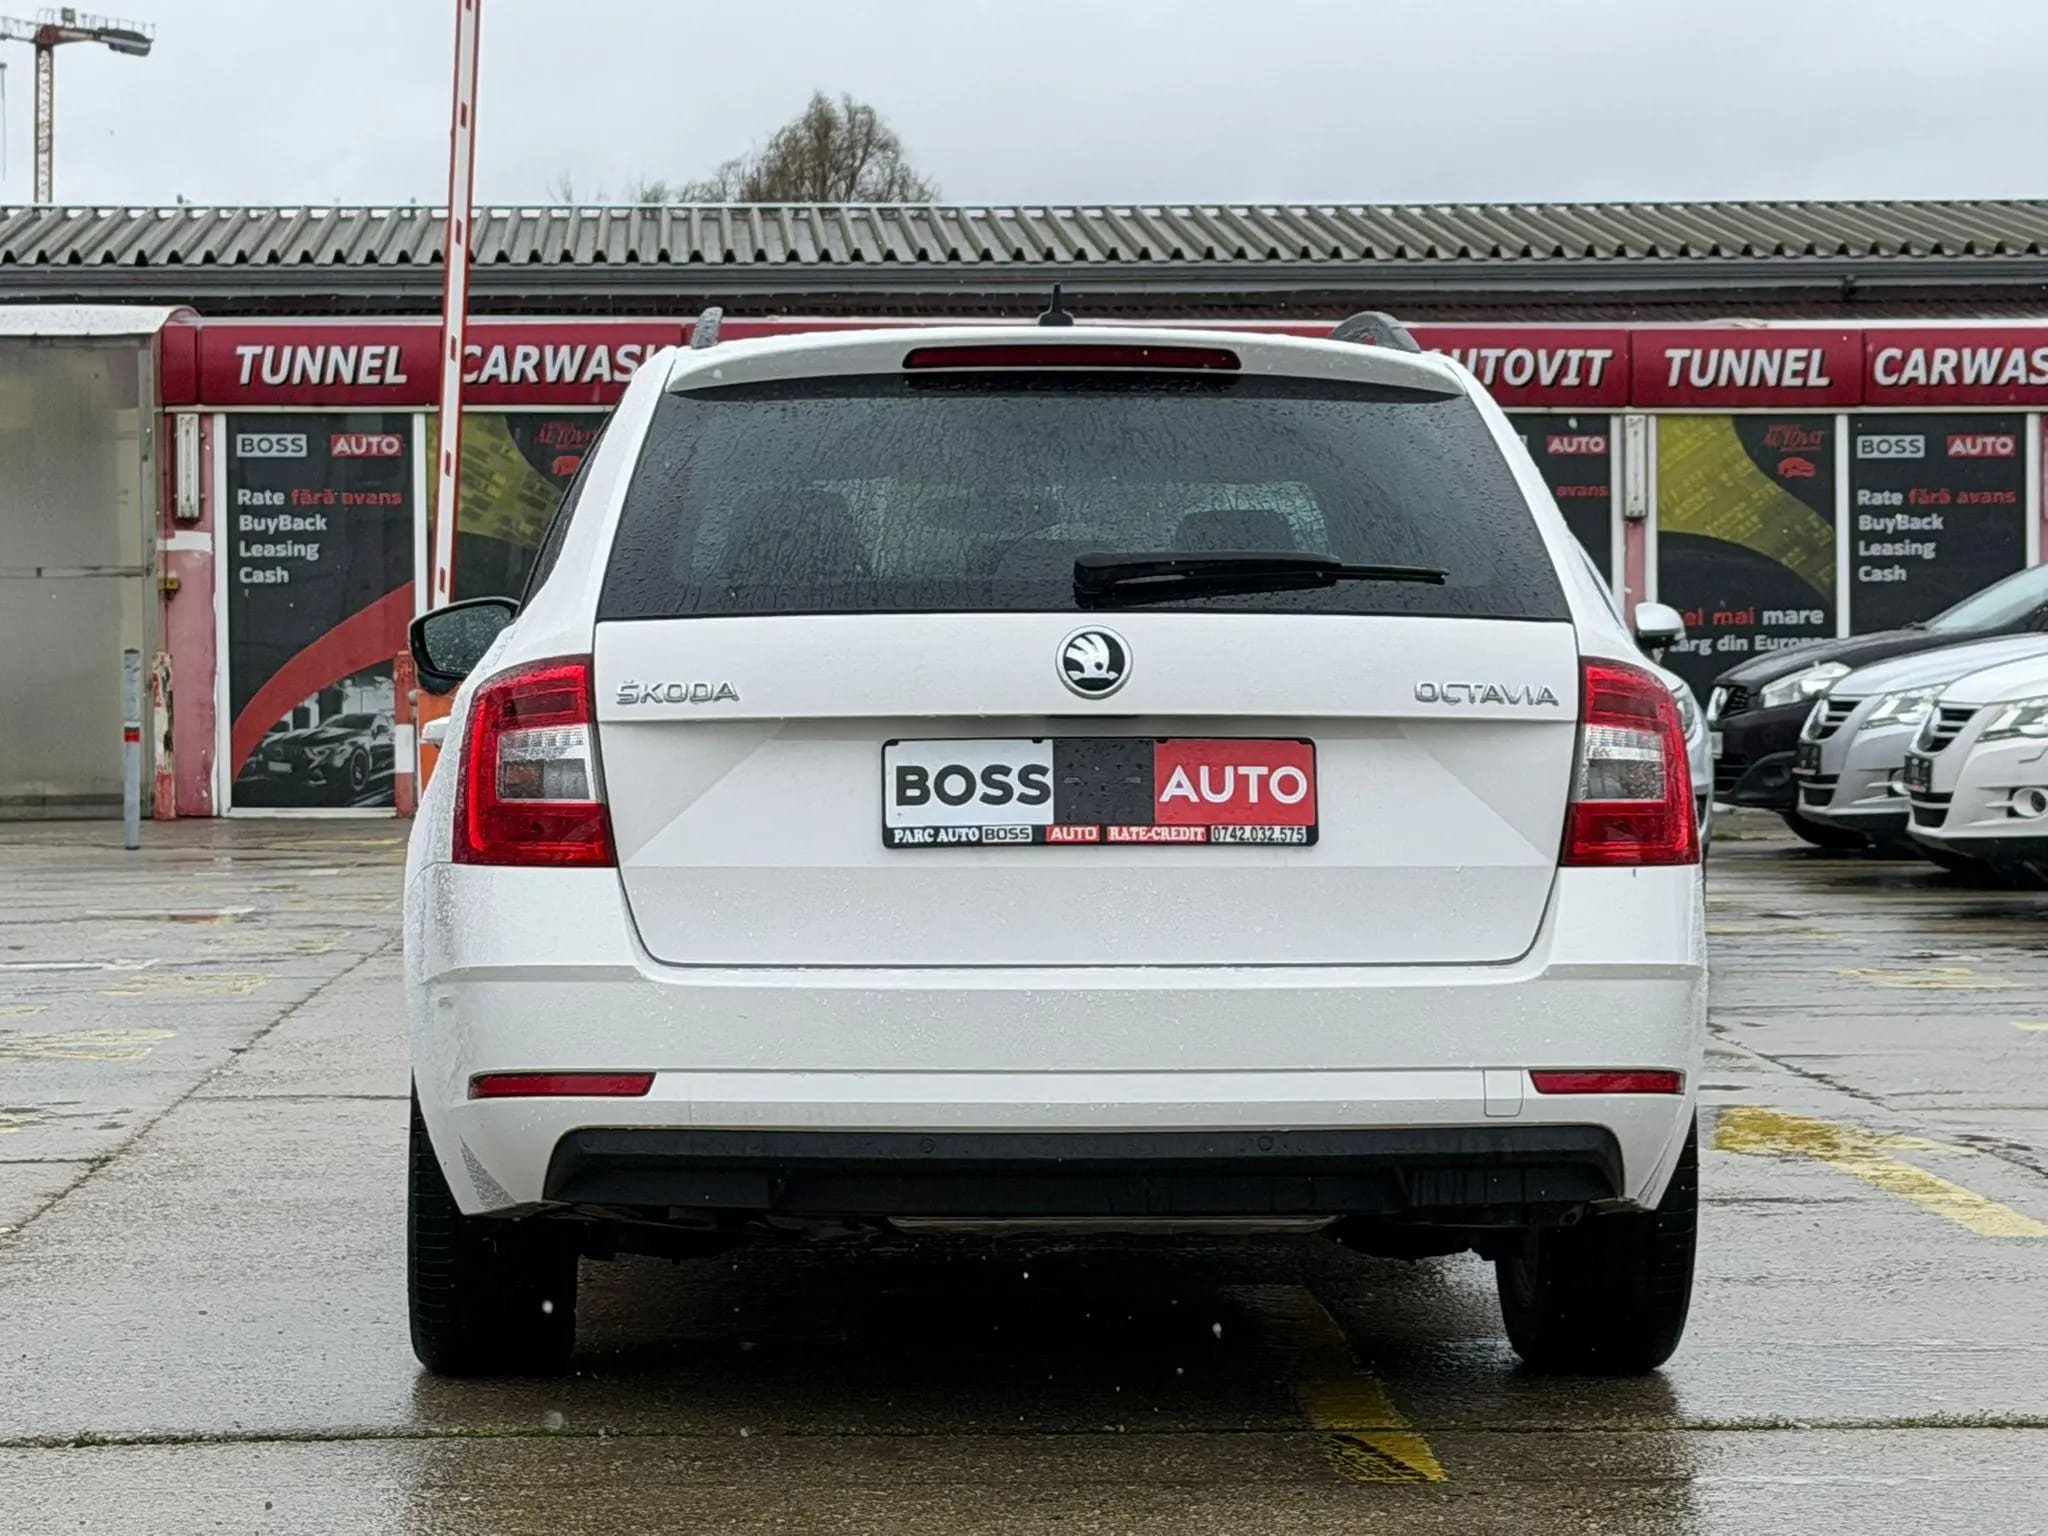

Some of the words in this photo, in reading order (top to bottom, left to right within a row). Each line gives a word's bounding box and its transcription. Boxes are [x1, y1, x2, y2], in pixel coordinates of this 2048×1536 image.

[235, 345, 408, 386] TUNNEL
[1664, 348, 1831, 388] TUNNEL
[240, 436, 305, 455] BOSS
[334, 435, 401, 455] AUTO
[1548, 435, 1606, 453] AUTO
[1860, 438, 1922, 455] BOSS
[1948, 436, 2014, 456] AUTO
[237, 489, 285, 505] Rate
[341, 490, 402, 506] avans
[1857, 489, 1904, 505] Rate
[1957, 491, 2016, 505] avans
[239, 514, 328, 535] BuyBack
[1858, 513, 1944, 534] BuyBack
[239, 540, 320, 561] Leasing
[1858, 539, 1936, 559] Leasing
[239, 566, 290, 584] Cash
[1858, 565, 1907, 582] Cash
[1712, 608, 1756, 625] mai
[1762, 608, 1825, 625] mare
[1717, 634, 1749, 651] din
[616, 680, 740, 705] ŠKODA
[1414, 681, 1560, 706] OCTAVIA
[896, 764, 1052, 806] BOSS
[1158, 765, 1308, 804] AUTO
[894, 829, 934, 843] PARC
[937, 828, 979, 842] AUTO
[985, 827, 1030, 841] BOSS
[1050, 826, 1098, 840] AUTO
[1109, 826, 1206, 841] RATE-CREDIT
[1212, 826, 1305, 842] 0742.032.575
